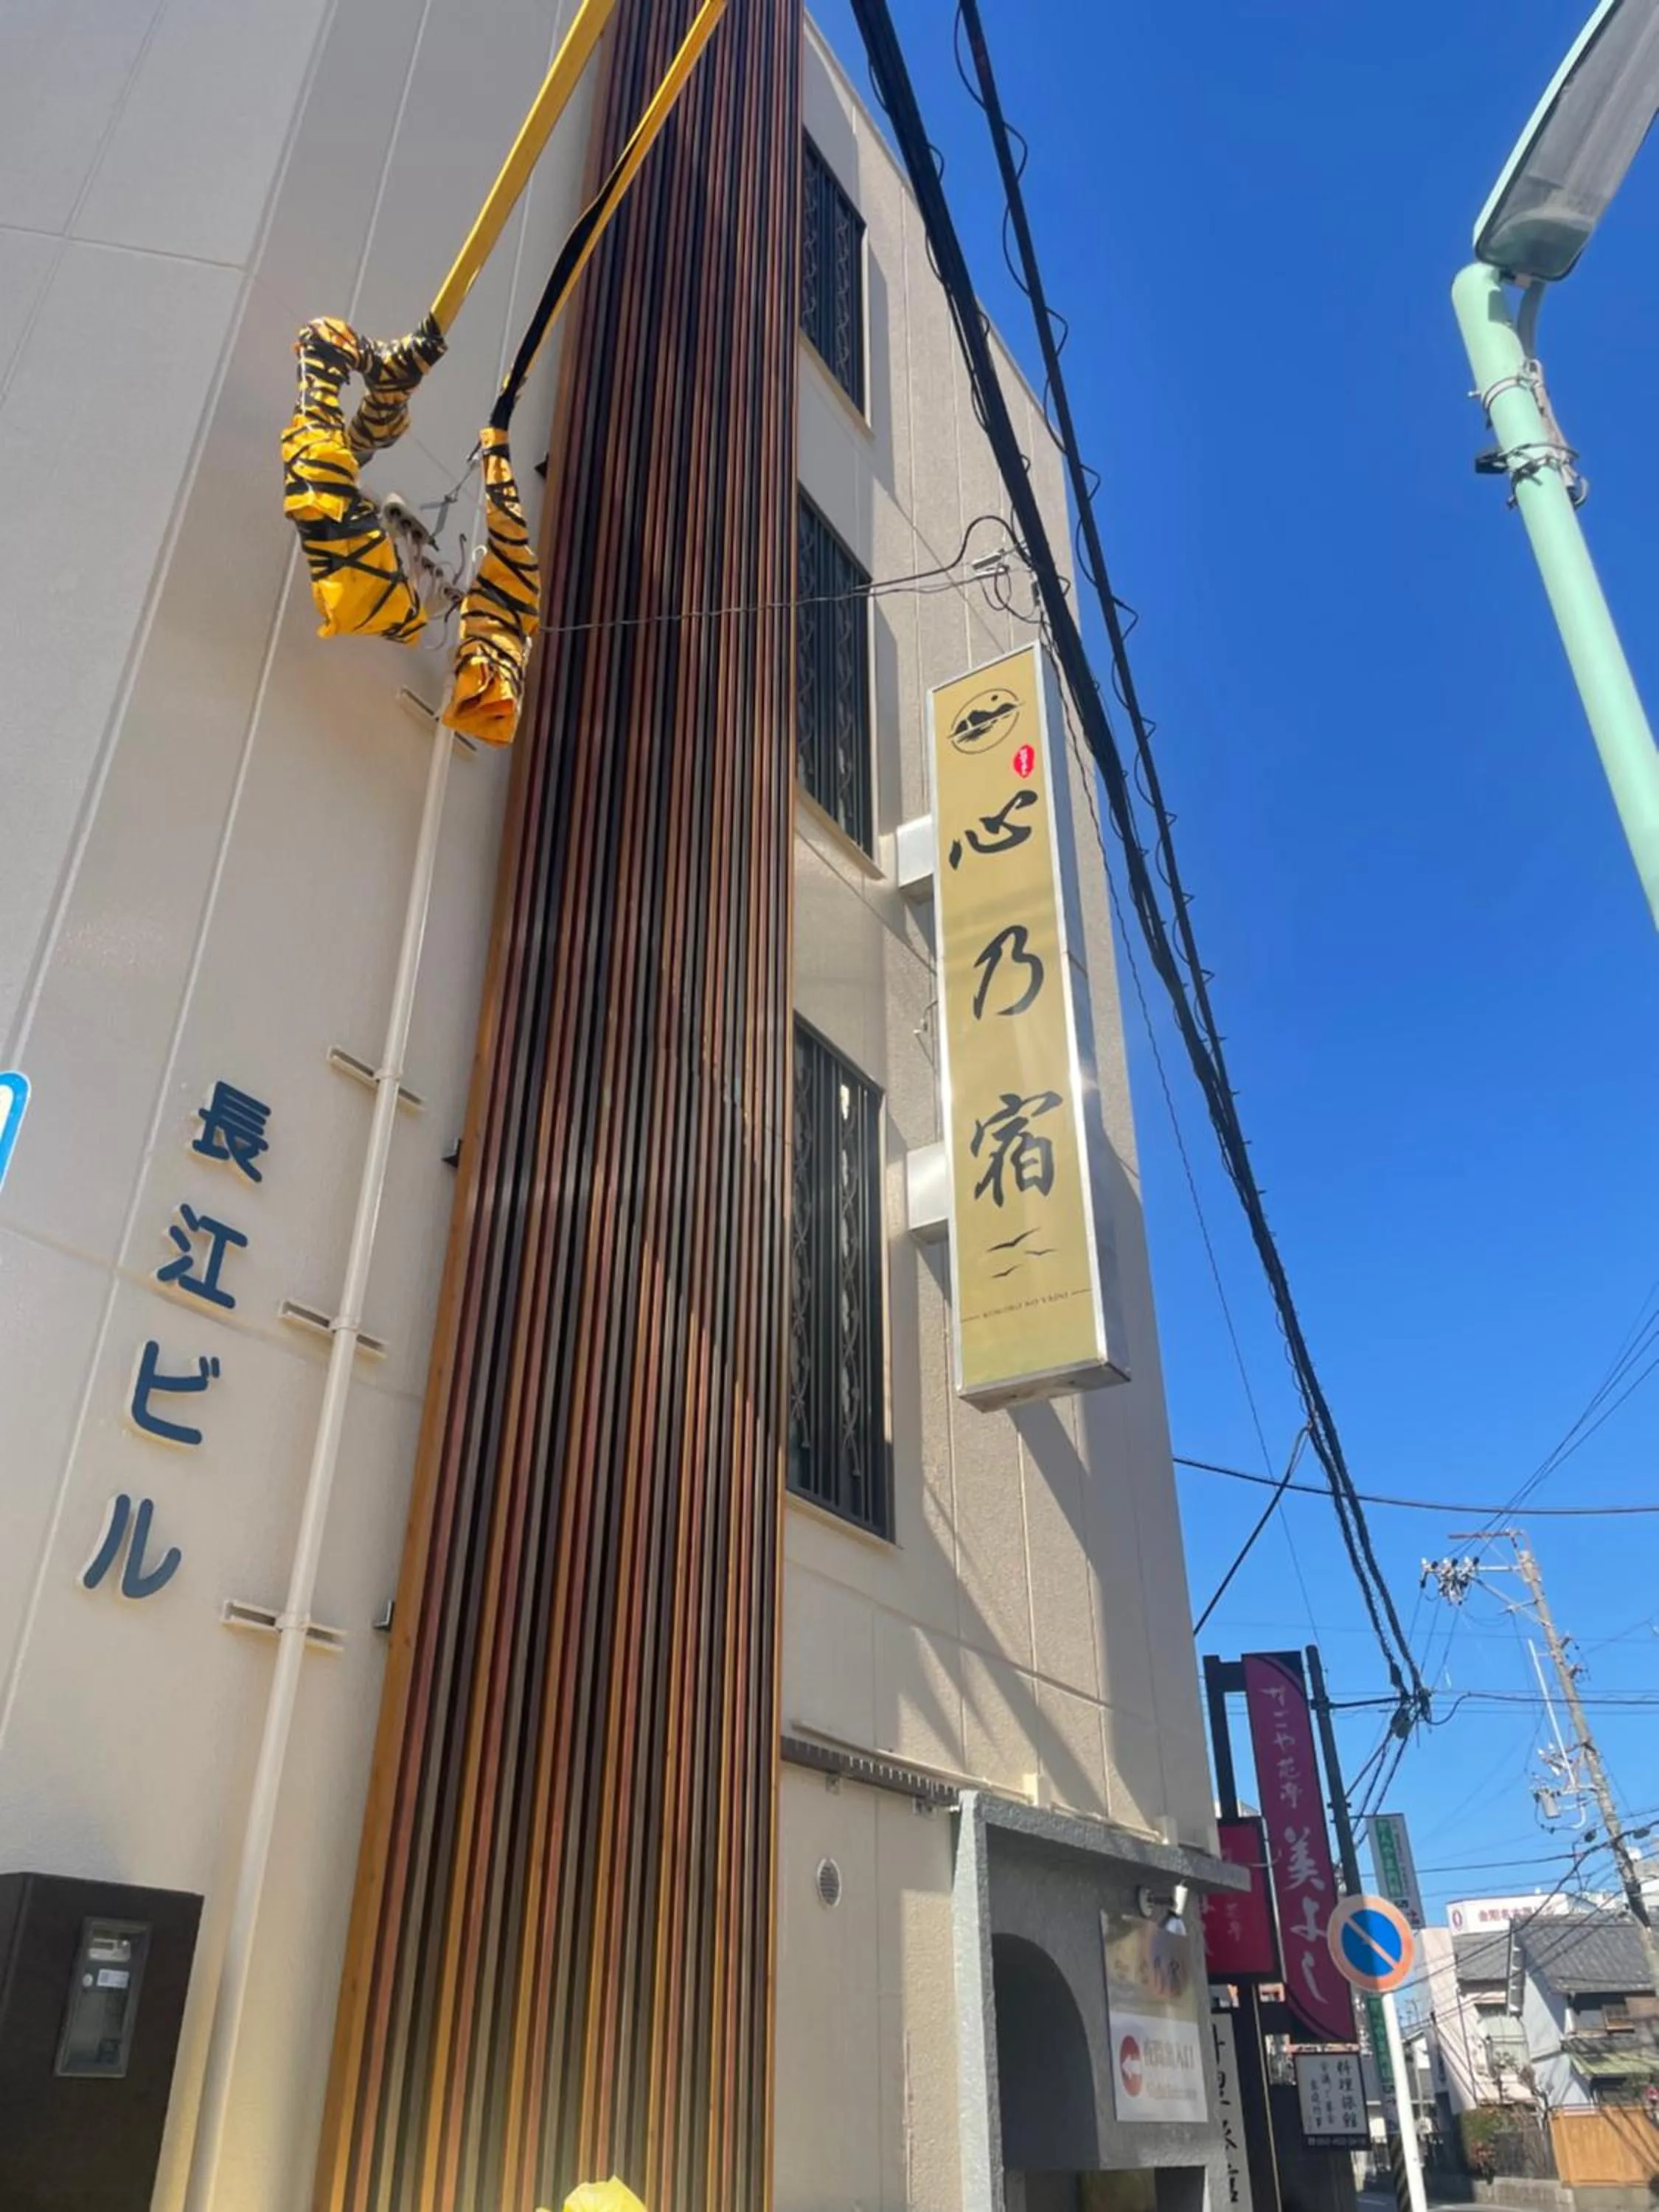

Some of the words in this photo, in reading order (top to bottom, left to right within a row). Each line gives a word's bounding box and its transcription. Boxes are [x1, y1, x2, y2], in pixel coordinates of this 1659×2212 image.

[949, 790, 1063, 1207] 心乃宿
[81, 1079, 272, 1599] 長江ビル
